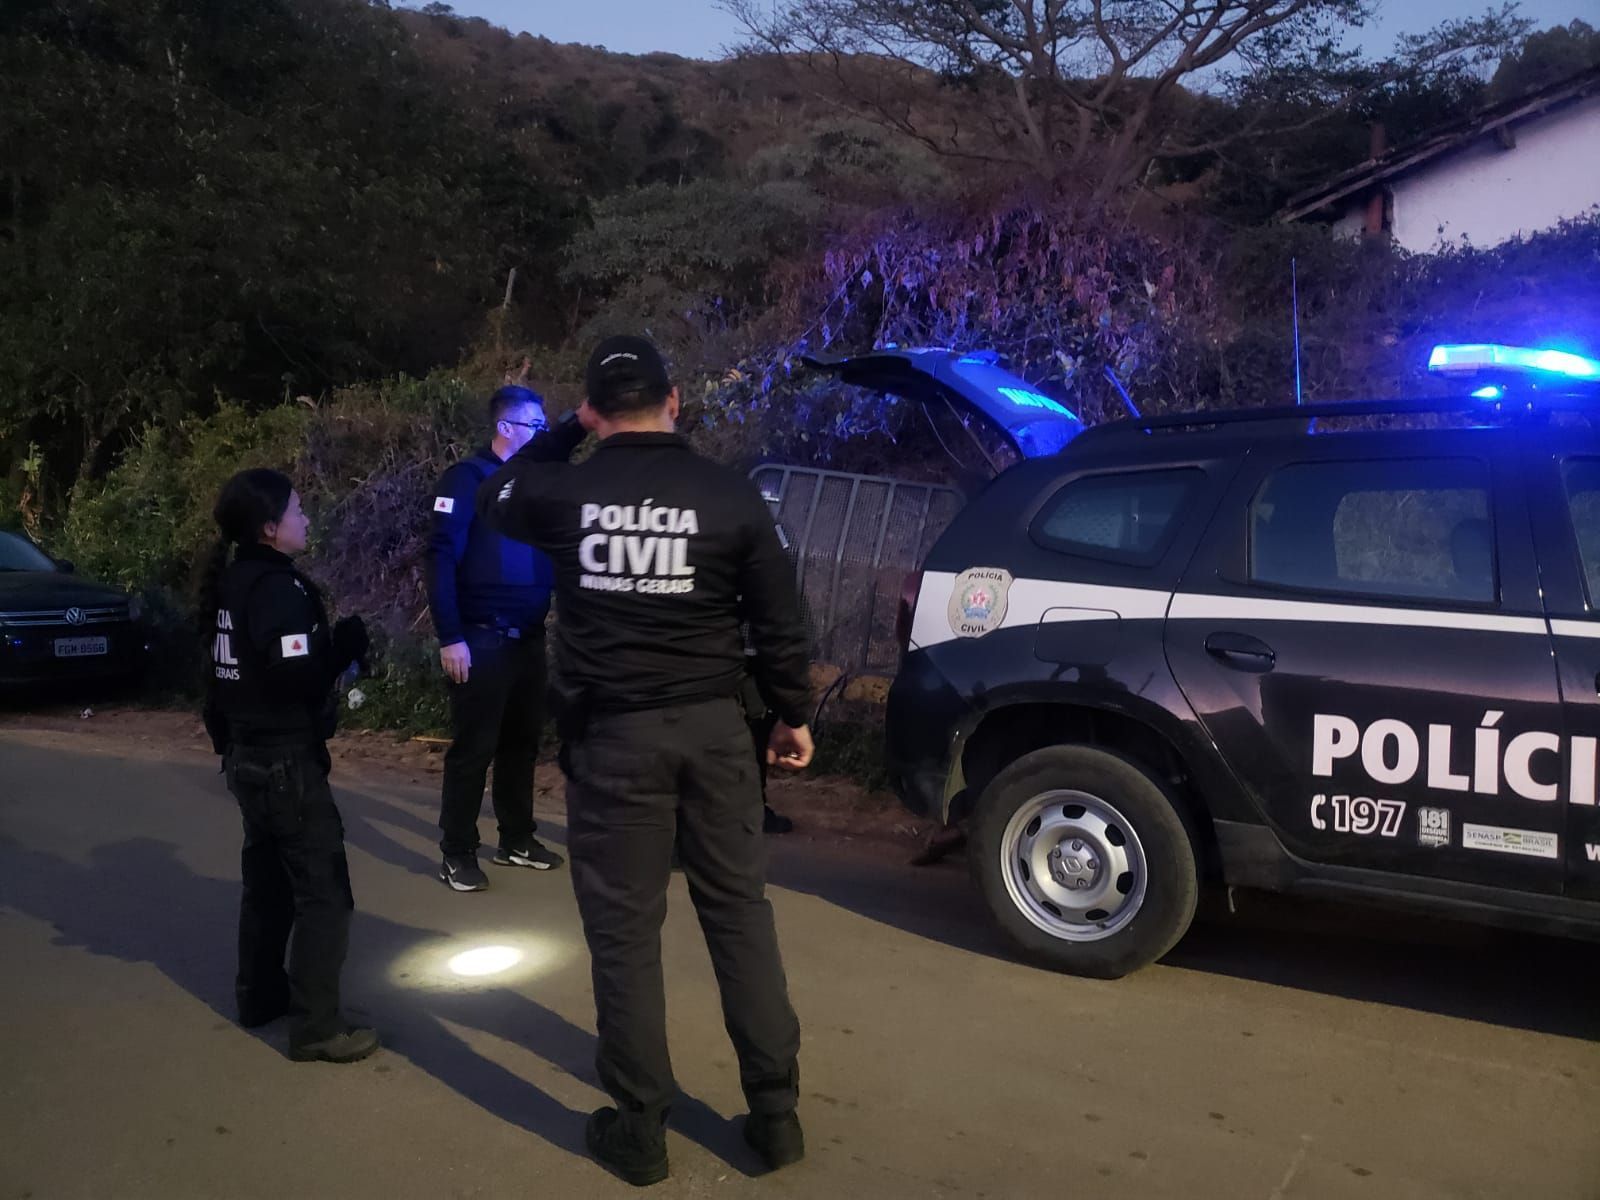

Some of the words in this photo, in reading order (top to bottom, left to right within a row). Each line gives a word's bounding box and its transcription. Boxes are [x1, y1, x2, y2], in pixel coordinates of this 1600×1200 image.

[579, 497, 699, 535] POLÍCIA
[578, 533, 696, 576] CIVIL
[579, 573, 635, 592] MINAS
[635, 577, 695, 595] GERAIS
[968, 571, 1003, 582] POLÍCIA
[960, 623, 987, 633] CIVIL
[215, 665, 240, 681] GERAIS
[1312, 710, 1600, 806] POLÍCI
[1331, 795, 1406, 837] 197
[1420, 809, 1448, 829] 181
[1522, 837, 1553, 848] BRASIL
